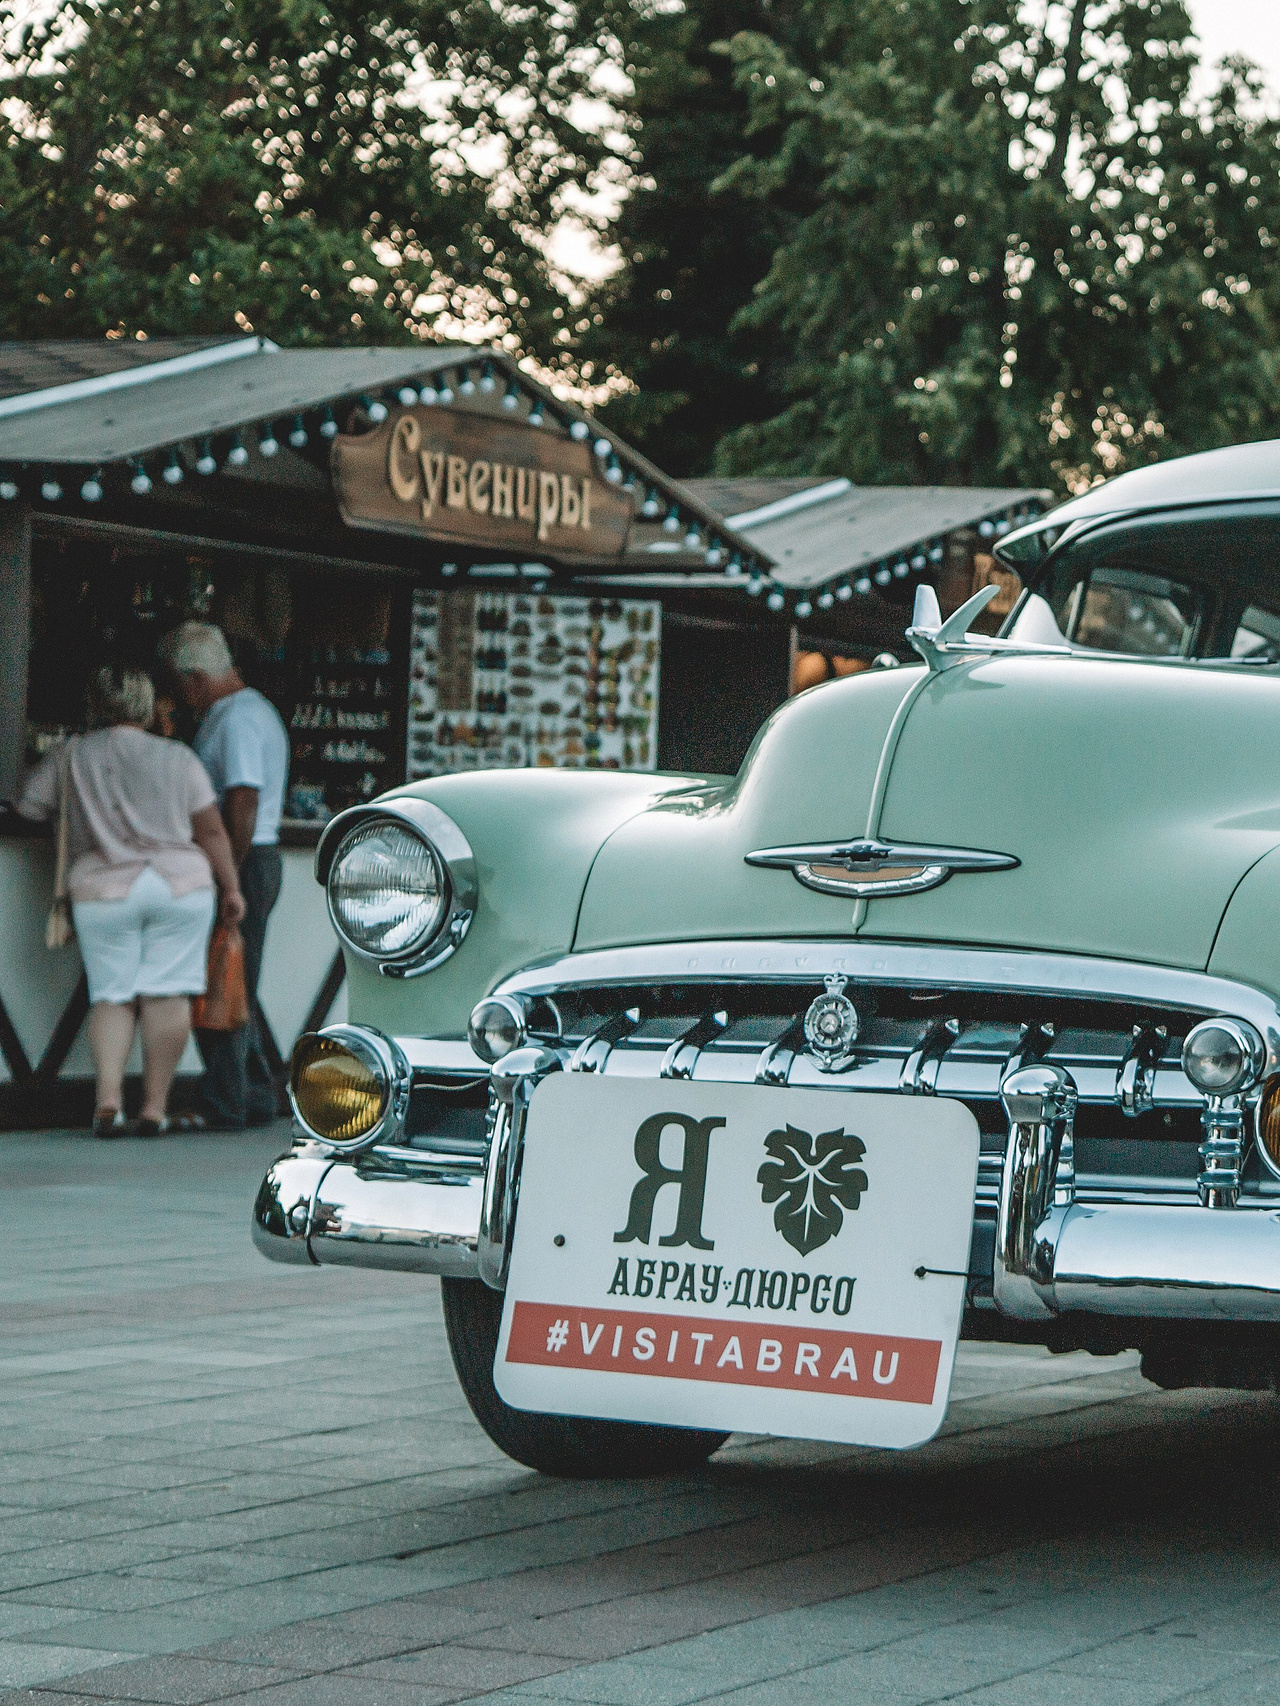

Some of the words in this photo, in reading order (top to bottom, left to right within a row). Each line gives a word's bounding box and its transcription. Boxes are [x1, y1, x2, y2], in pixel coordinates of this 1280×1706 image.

[389, 414, 591, 540] Сувениры
[613, 1111, 727, 1251] Я
[546, 1320, 899, 1385] #VISITABRAU
